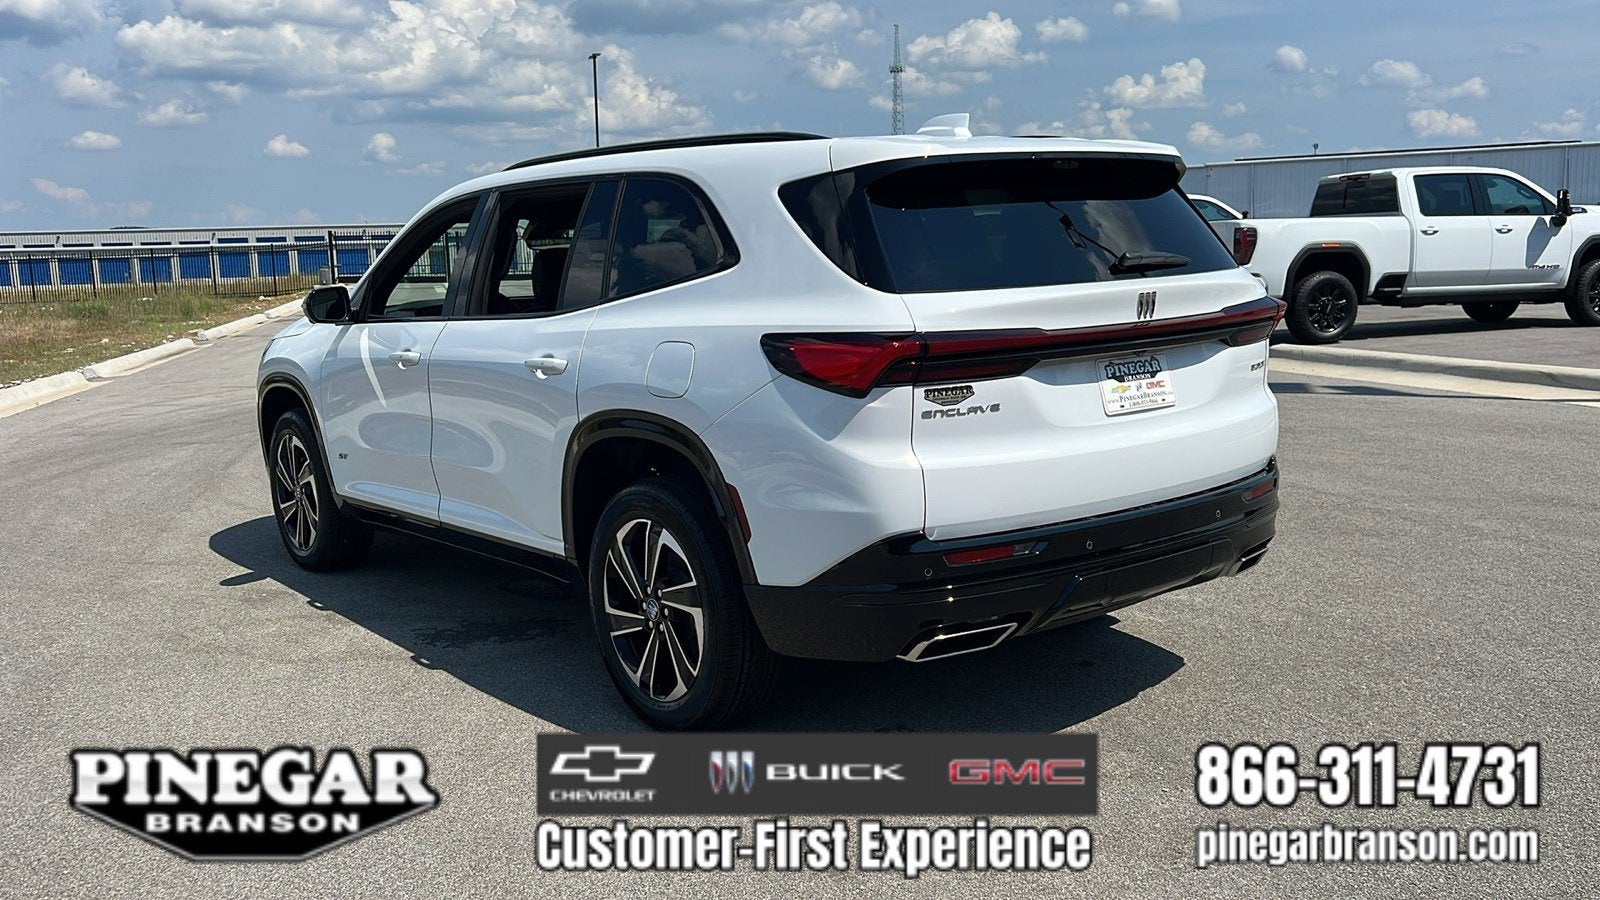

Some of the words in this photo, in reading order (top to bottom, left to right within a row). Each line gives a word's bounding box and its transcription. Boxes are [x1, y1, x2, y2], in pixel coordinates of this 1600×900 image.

[1106, 360, 1161, 378] PINEGAR
[1124, 373, 1152, 382] BRANSON
[925, 385, 974, 399] PINEGAR
[1146, 380, 1166, 390] GMC
[921, 403, 1001, 420] ENCLAVE
